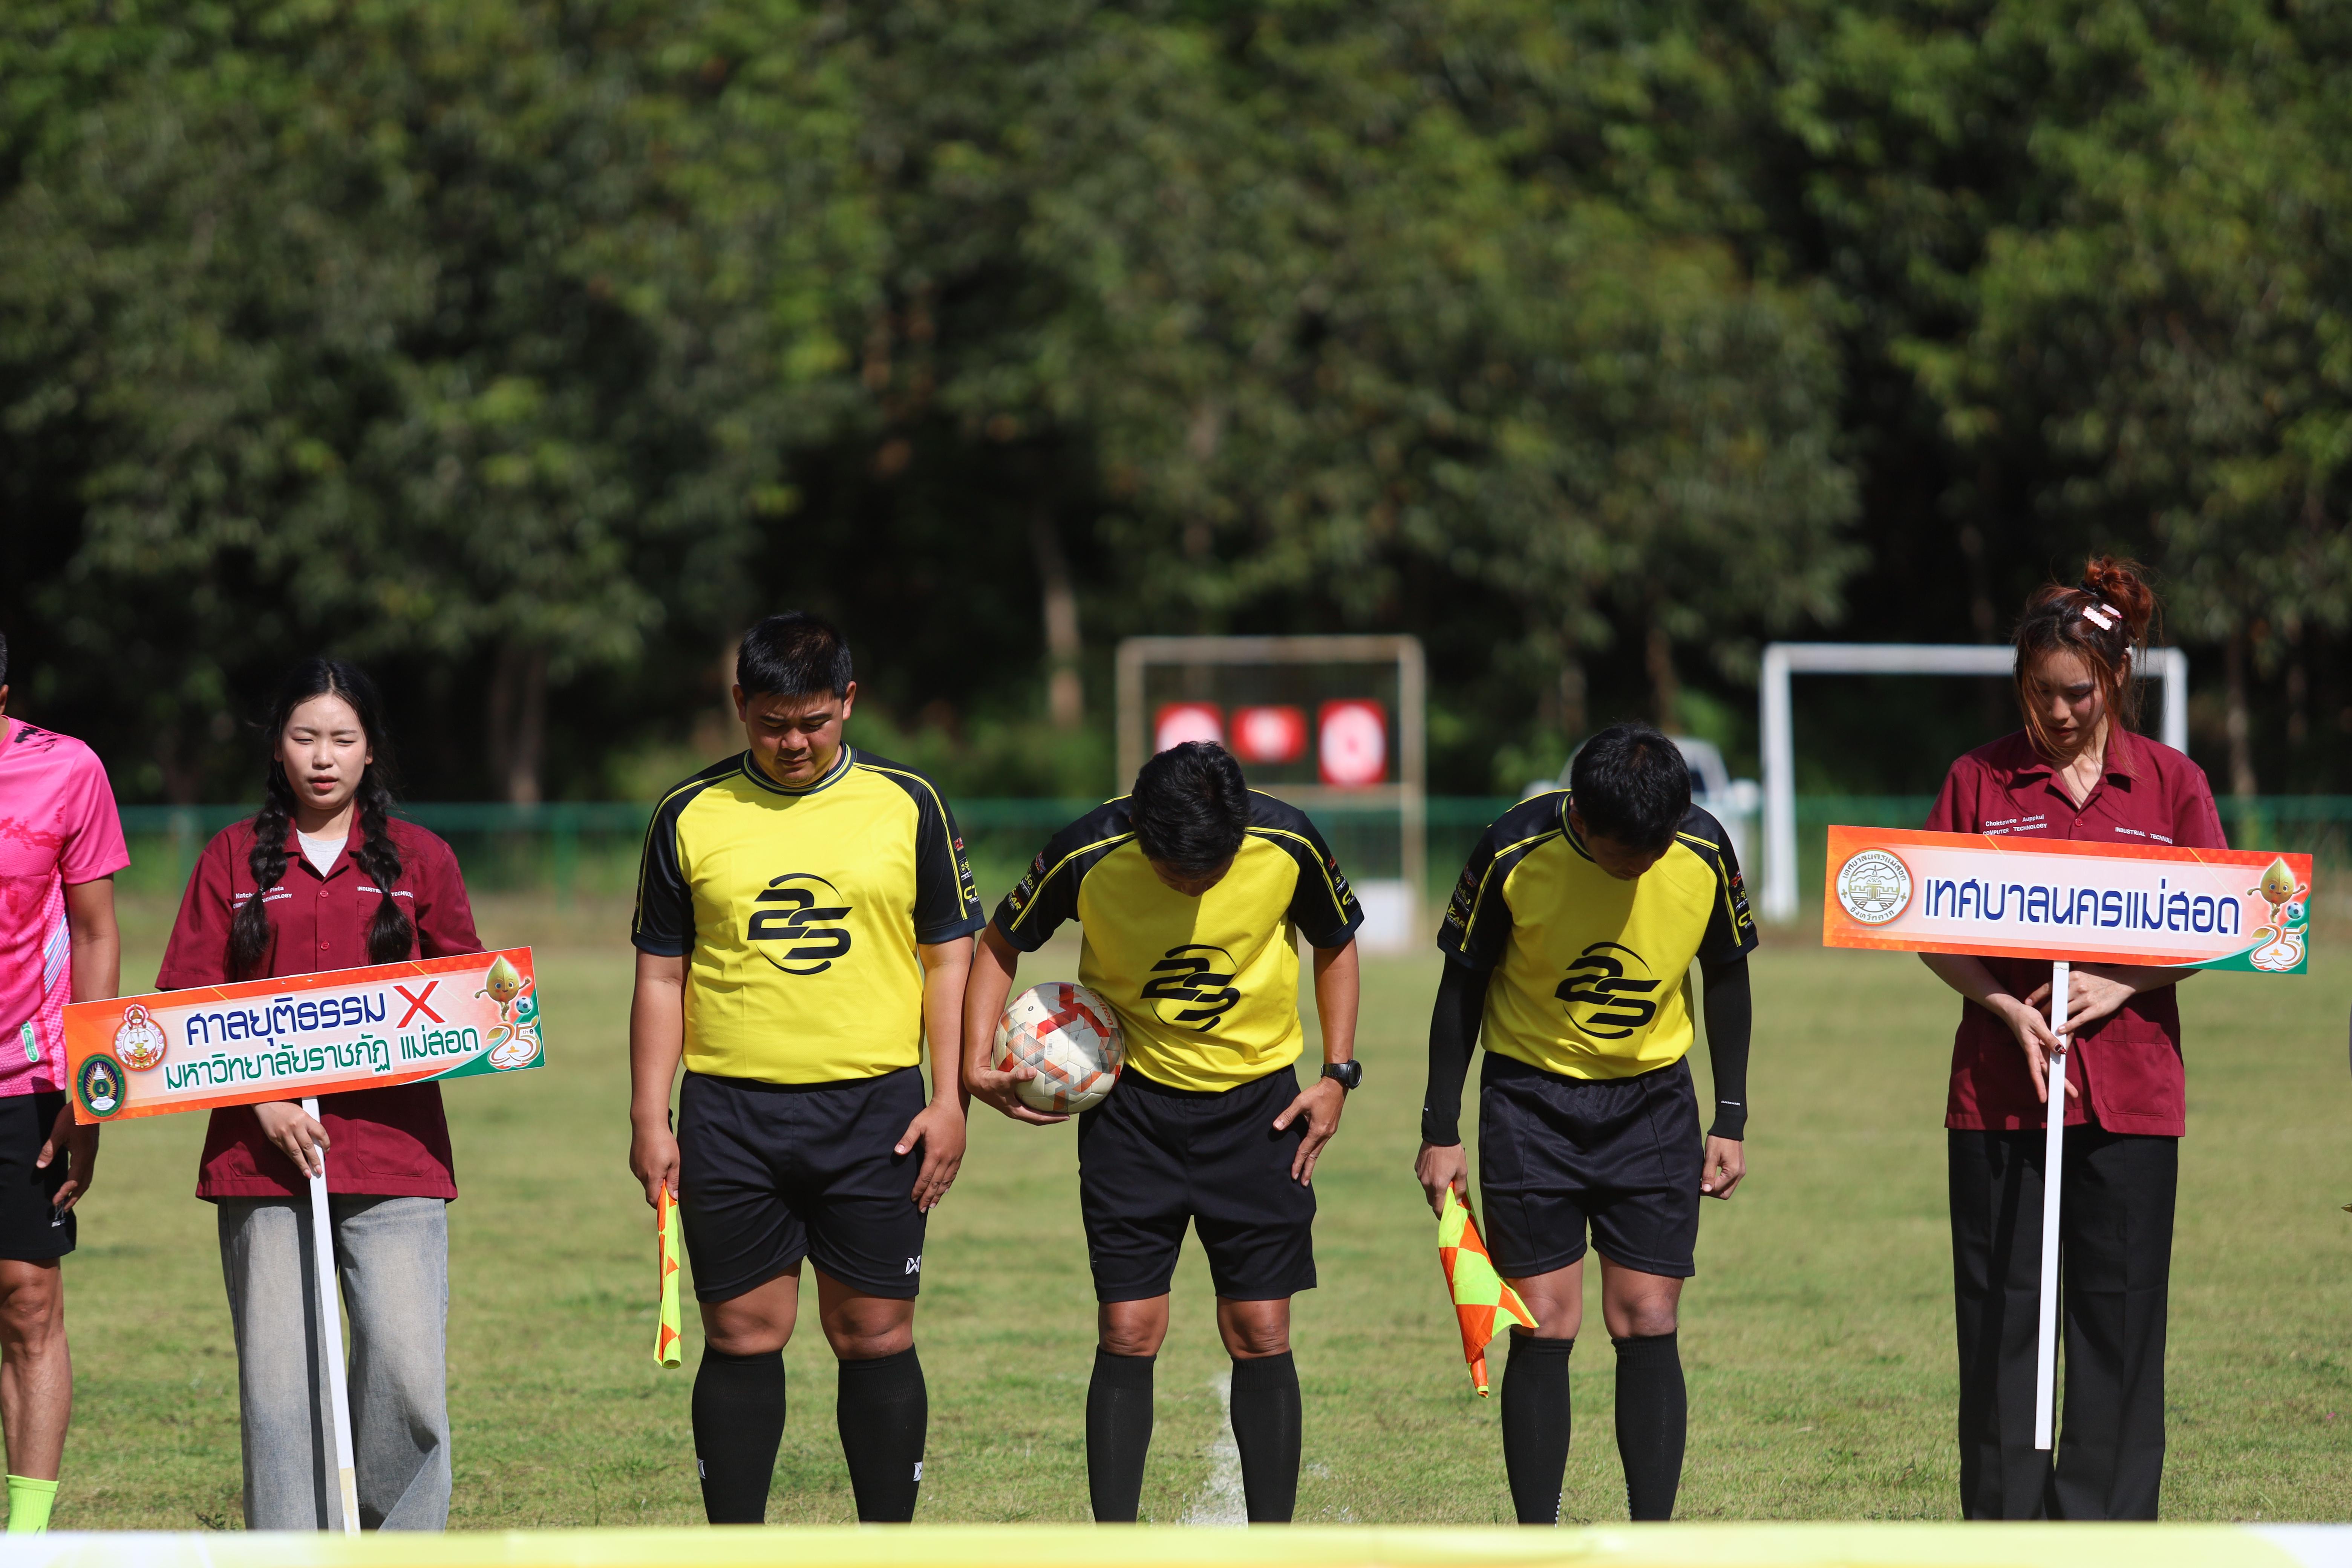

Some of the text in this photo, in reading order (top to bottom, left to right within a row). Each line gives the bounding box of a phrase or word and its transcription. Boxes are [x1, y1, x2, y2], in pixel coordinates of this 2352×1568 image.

[1986, 814, 2044, 827] Choktawee Auppkul
[2115, 827, 2173, 844] INDUSTRIAL TECHNOL
[262, 893, 292, 903] ECHNOLOGY
[1925, 879, 2239, 934] เทศบาลนครแม่สอด
[187, 993, 386, 1046] ศาลยุติธรรม
[165, 1034, 390, 1089] มหาวิทยาลัยราชภัฏ
[400, 1024, 479, 1060] แม่สอด
